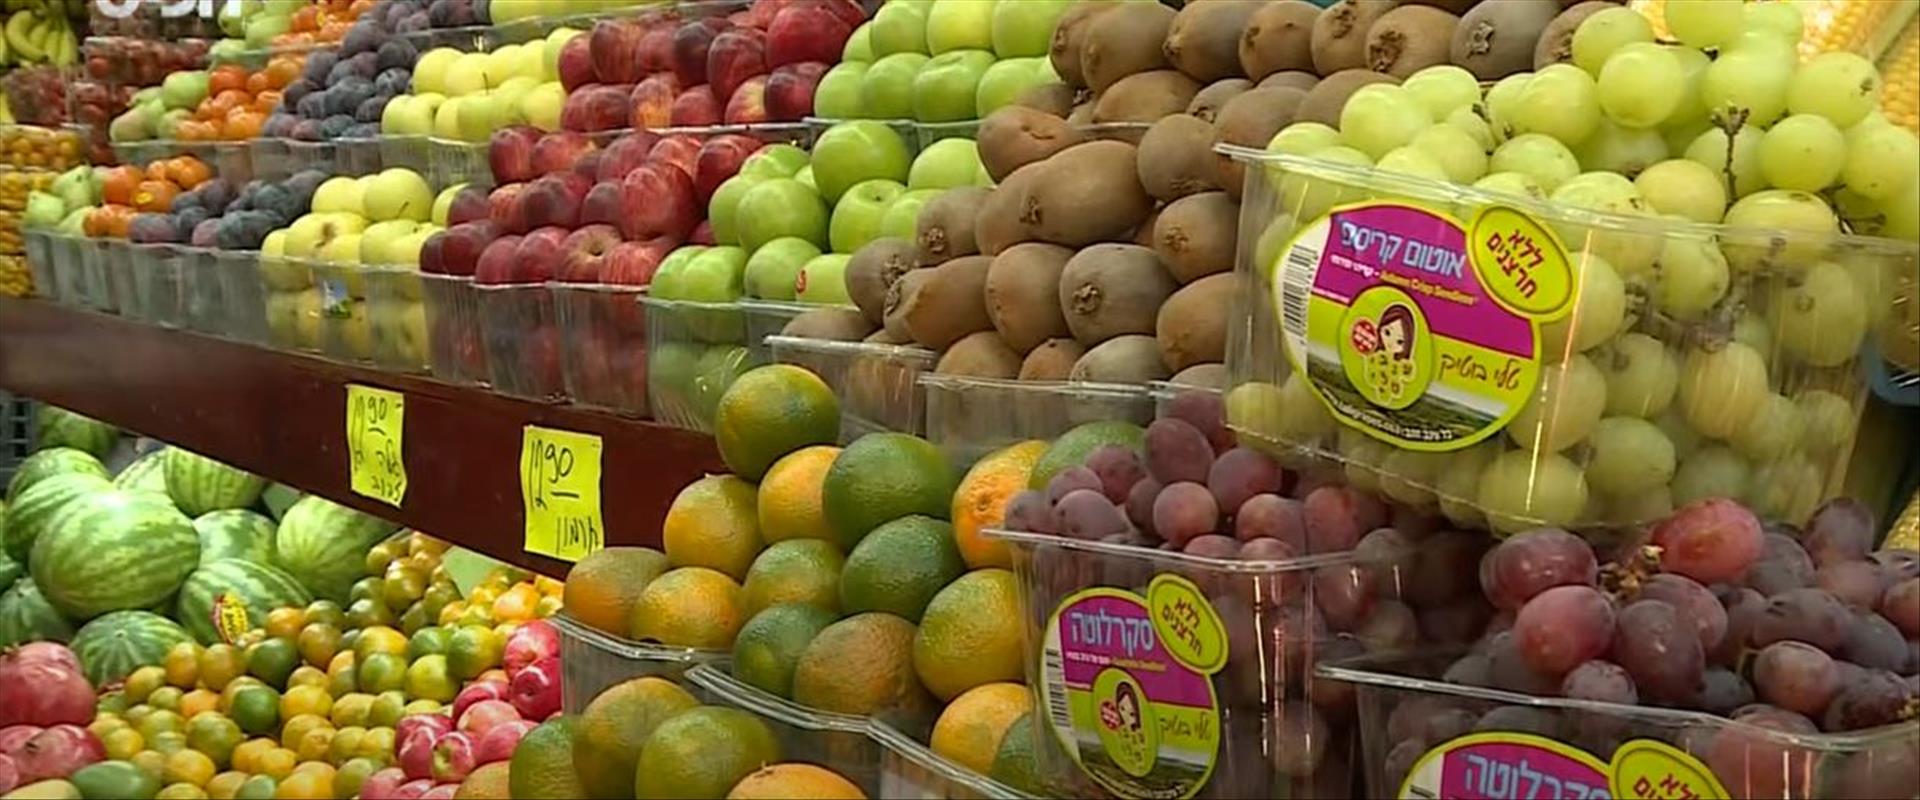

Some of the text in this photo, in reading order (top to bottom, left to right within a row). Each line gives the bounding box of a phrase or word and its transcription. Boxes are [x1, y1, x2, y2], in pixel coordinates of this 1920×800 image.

[1402, 239, 1467, 279] אוטום
[1486, 232, 1537, 299] חרצנים
[1507, 229, 1544, 269] ללא
[1070, 608, 1155, 656] סקרלוטה
[1174, 597, 1200, 628] ללא
